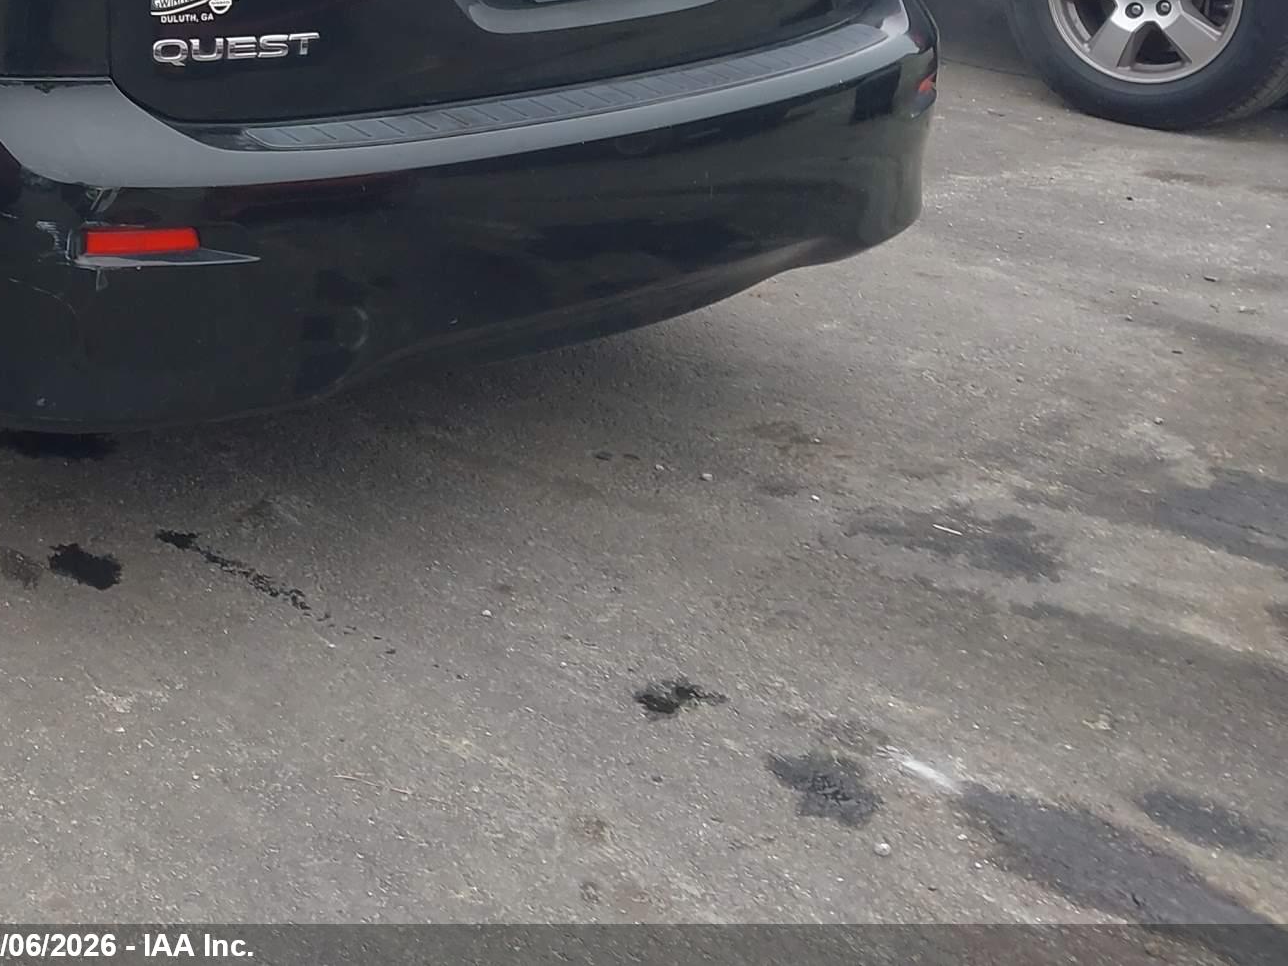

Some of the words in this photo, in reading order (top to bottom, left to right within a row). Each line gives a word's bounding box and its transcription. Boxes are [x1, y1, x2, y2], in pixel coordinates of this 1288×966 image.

[160, 14, 200, 24] DULUTH,
[200, 12, 214, 21] GA
[152, 32, 320, 66] QUEST
